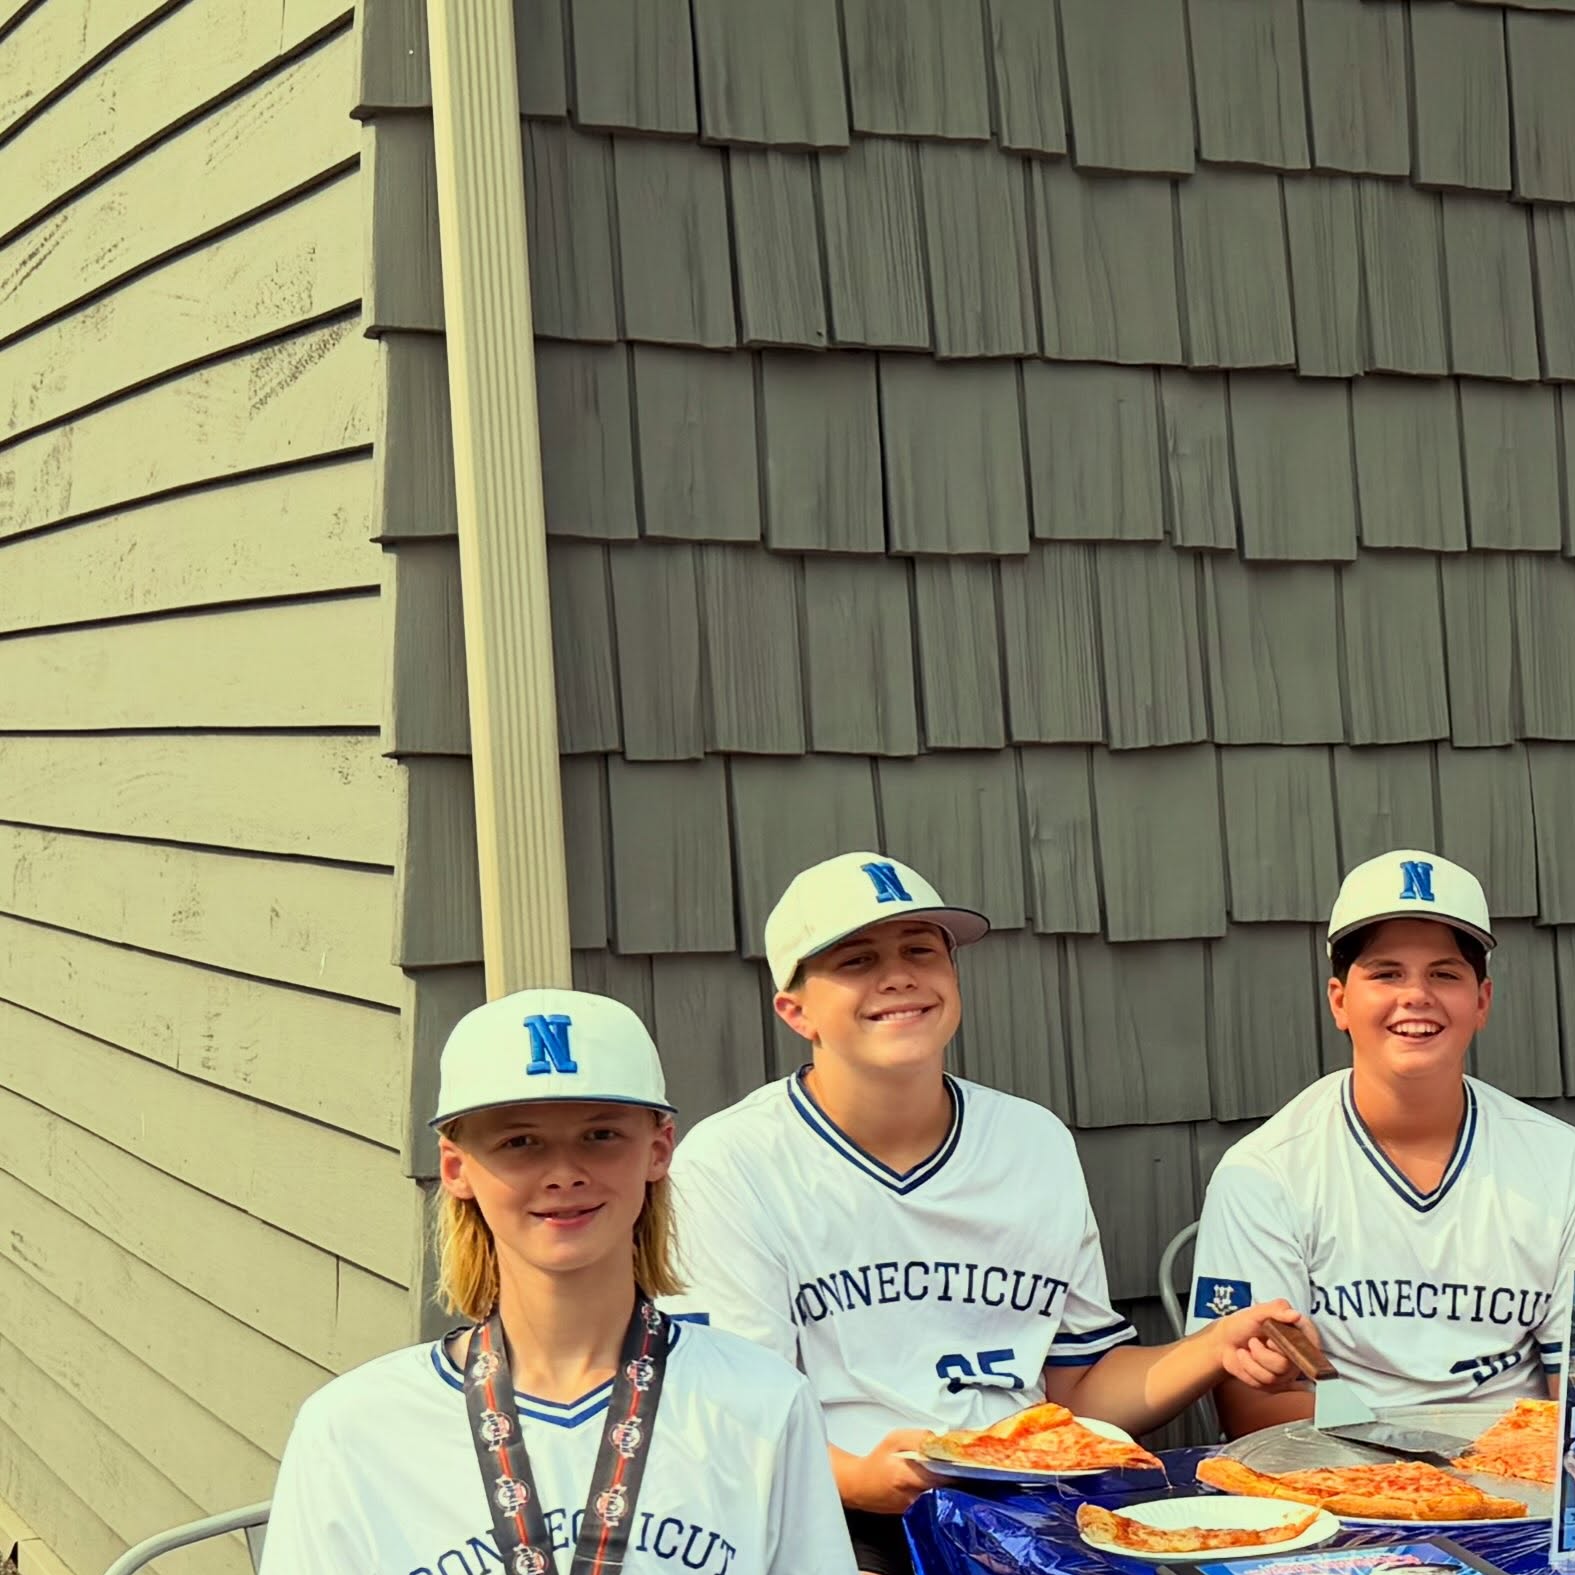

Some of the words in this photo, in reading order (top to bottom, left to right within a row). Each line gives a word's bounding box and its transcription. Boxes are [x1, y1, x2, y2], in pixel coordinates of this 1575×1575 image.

[860, 861, 913, 904] N
[1398, 860, 1436, 902] N
[523, 1014, 578, 1076] N
[790, 1260, 1070, 1327] ONNECTICUT
[1309, 1279, 1553, 1327] ONNECTICU
